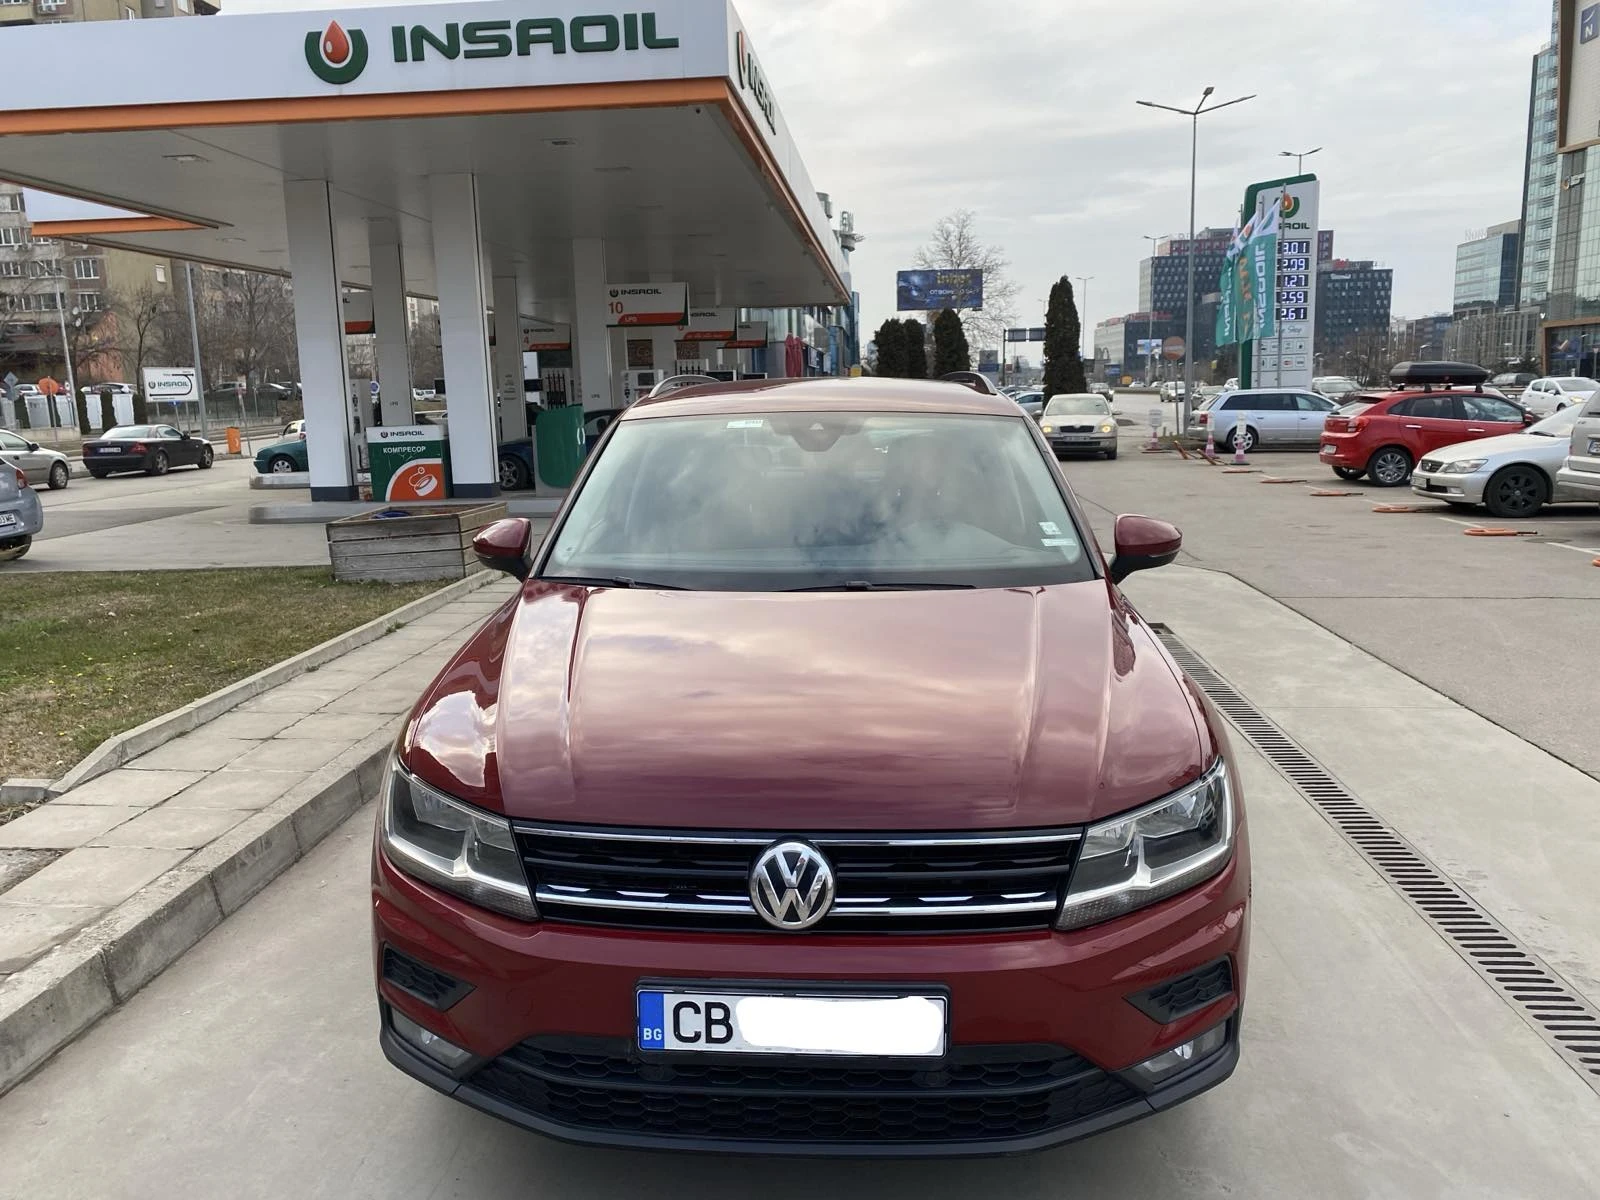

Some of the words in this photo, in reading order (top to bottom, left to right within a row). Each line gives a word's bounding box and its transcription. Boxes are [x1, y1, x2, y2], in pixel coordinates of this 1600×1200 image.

[392, 12, 679, 62] INSAOIL
[1284, 275, 1305, 287] 1.27
[1281, 291, 1304, 304] 2.59
[608, 302, 624, 314] 10
[1280, 308, 1304, 320] 2.61
[383, 446, 427, 454] КОМПРЕСОР
[643, 1028, 663, 1041] BG
